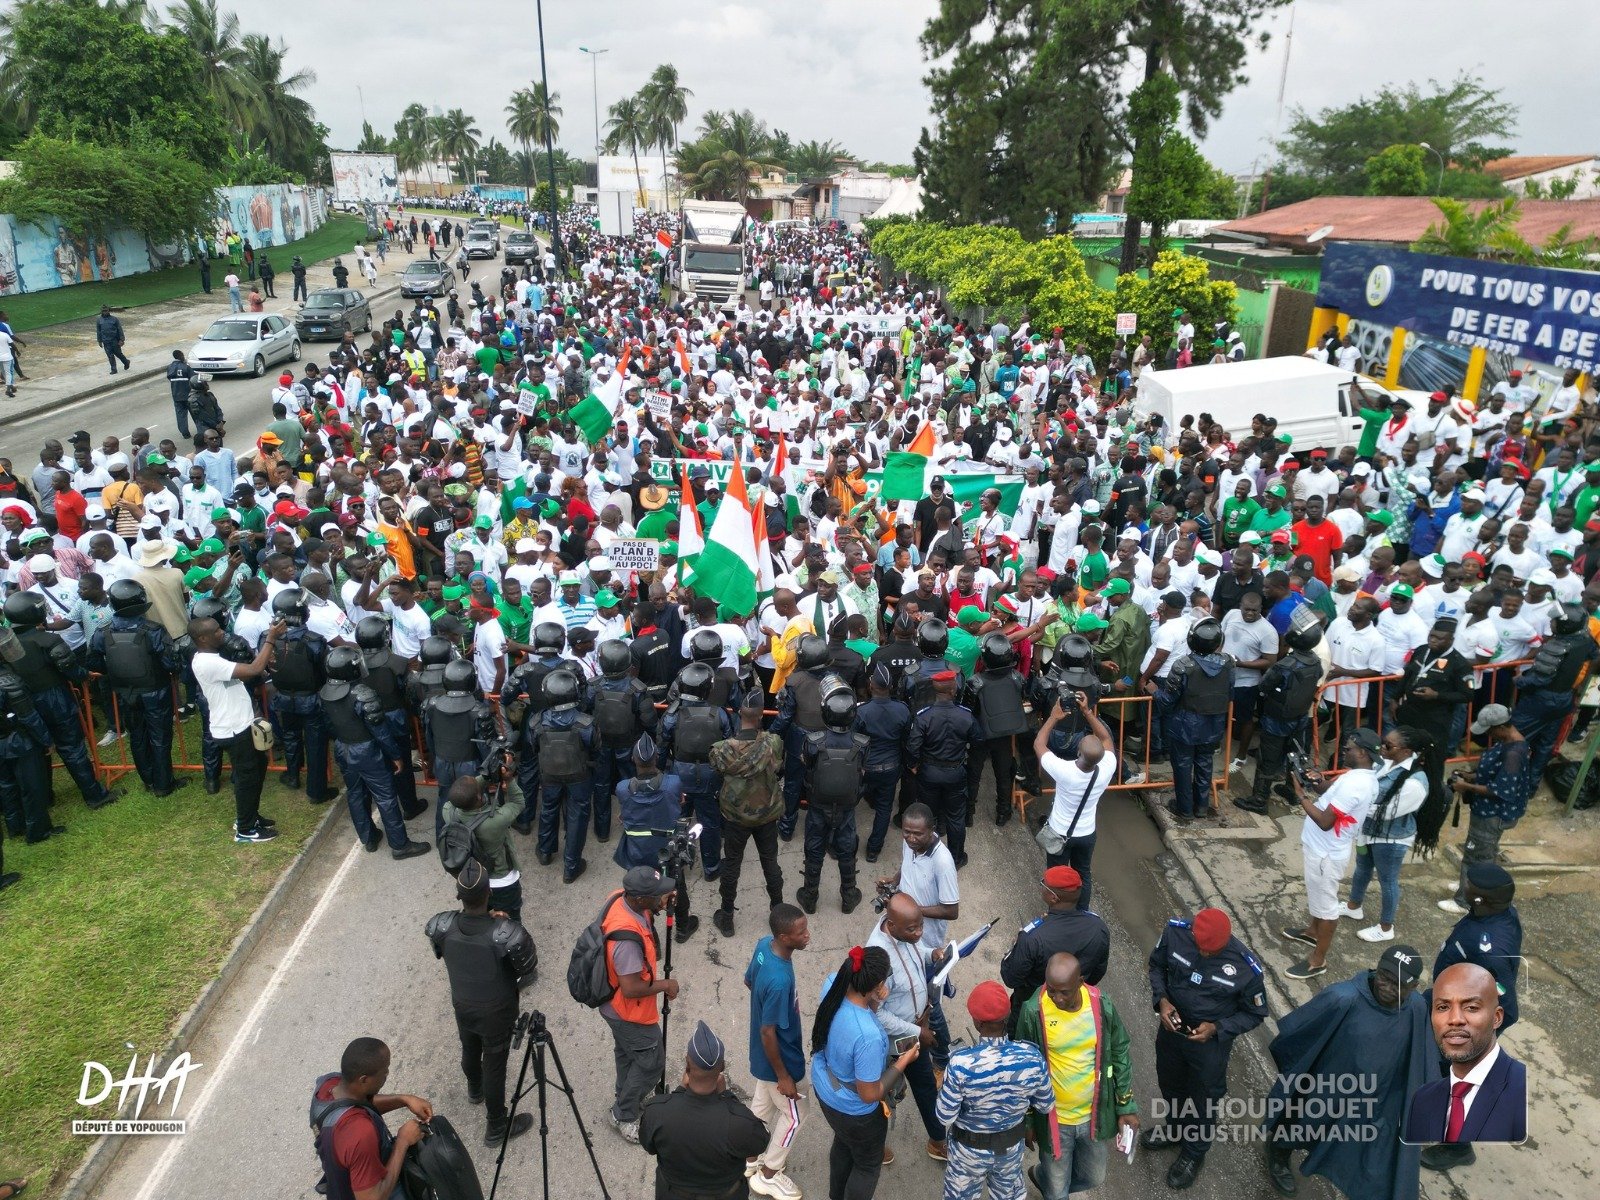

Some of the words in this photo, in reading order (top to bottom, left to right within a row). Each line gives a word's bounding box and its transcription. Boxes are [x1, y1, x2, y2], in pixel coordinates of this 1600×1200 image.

[1421, 268, 1476, 296] POUR
[1482, 276, 1545, 307] TOUS
[1553, 286, 1600, 318] VOS
[1450, 306, 1480, 332] DE
[1483, 313, 1530, 343] FER
[1534, 323, 1552, 348] A
[613, 547, 644, 555] PLAN
